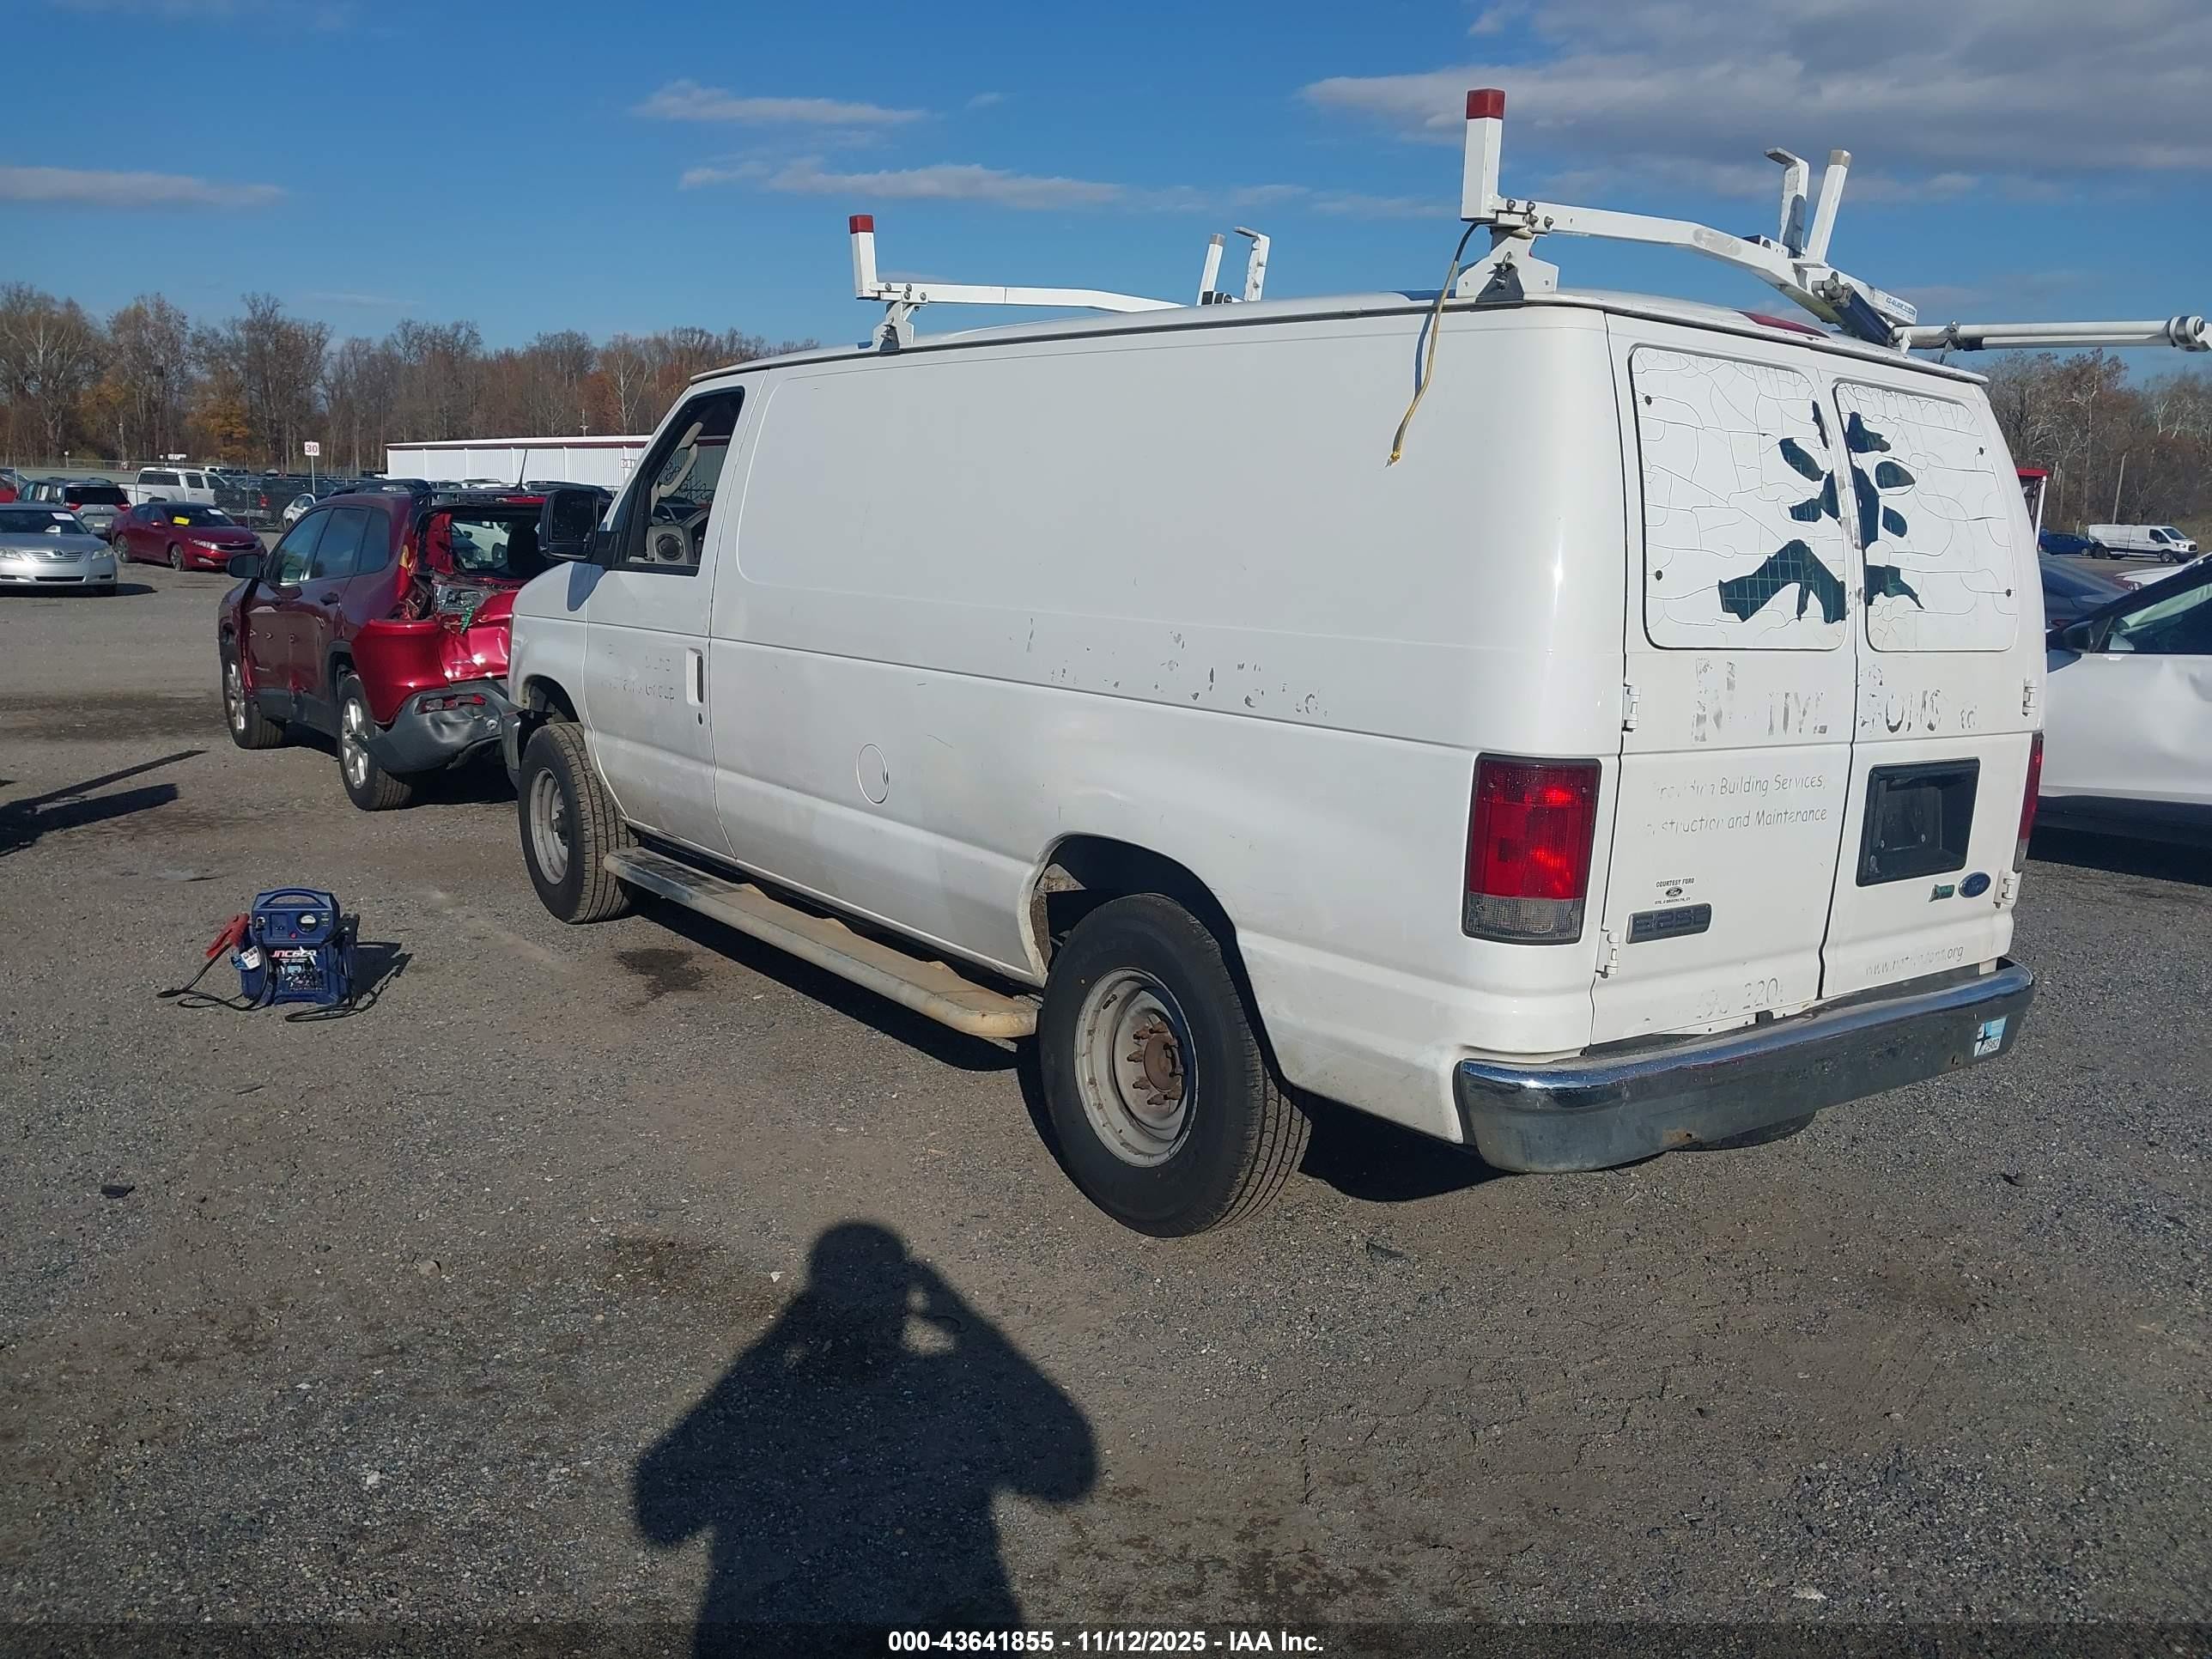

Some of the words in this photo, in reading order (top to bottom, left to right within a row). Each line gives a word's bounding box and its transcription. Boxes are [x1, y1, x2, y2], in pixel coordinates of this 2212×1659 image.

[306, 444, 318, 453] 30
[1720, 775, 1769, 797] Building
[1728, 811, 1751, 830] and
